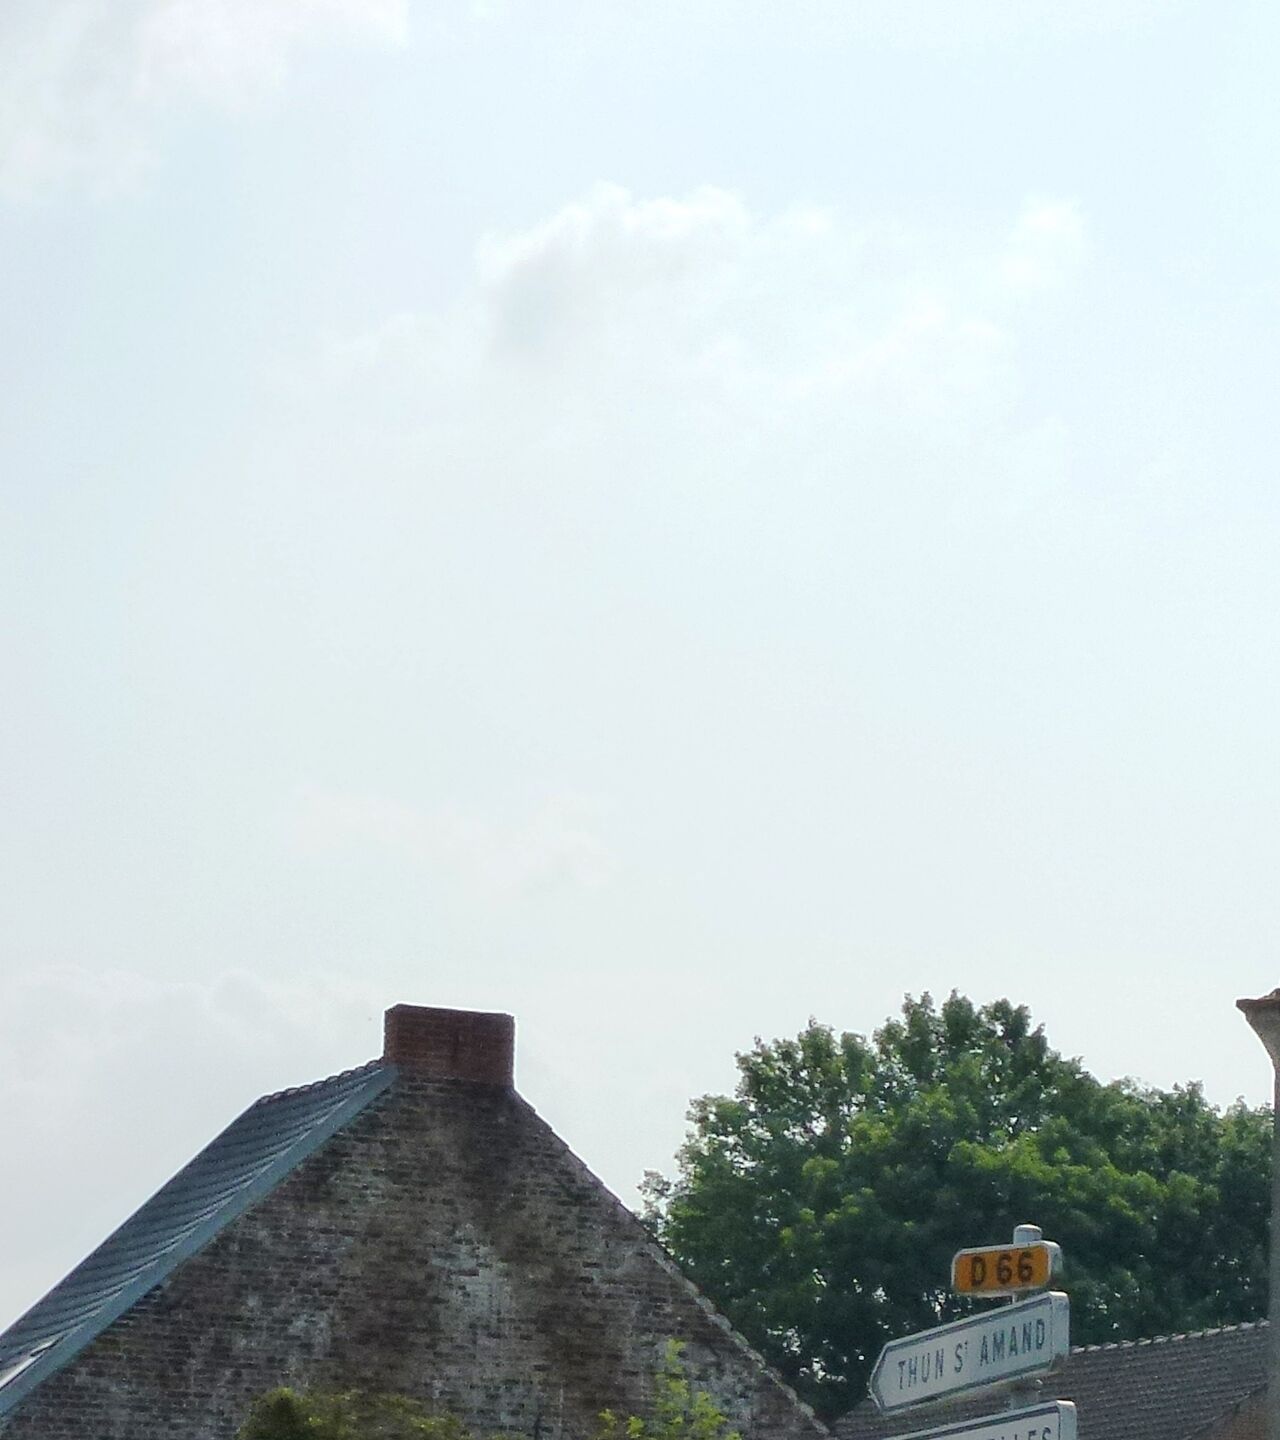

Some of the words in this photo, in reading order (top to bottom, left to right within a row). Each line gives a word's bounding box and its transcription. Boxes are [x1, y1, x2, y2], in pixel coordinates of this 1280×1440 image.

[970, 1255, 986, 1287] D
[996, 1251, 1033, 1285] 66
[898, 1347, 945, 1390] THUN
[979, 1318, 1046, 1367] AMAND
